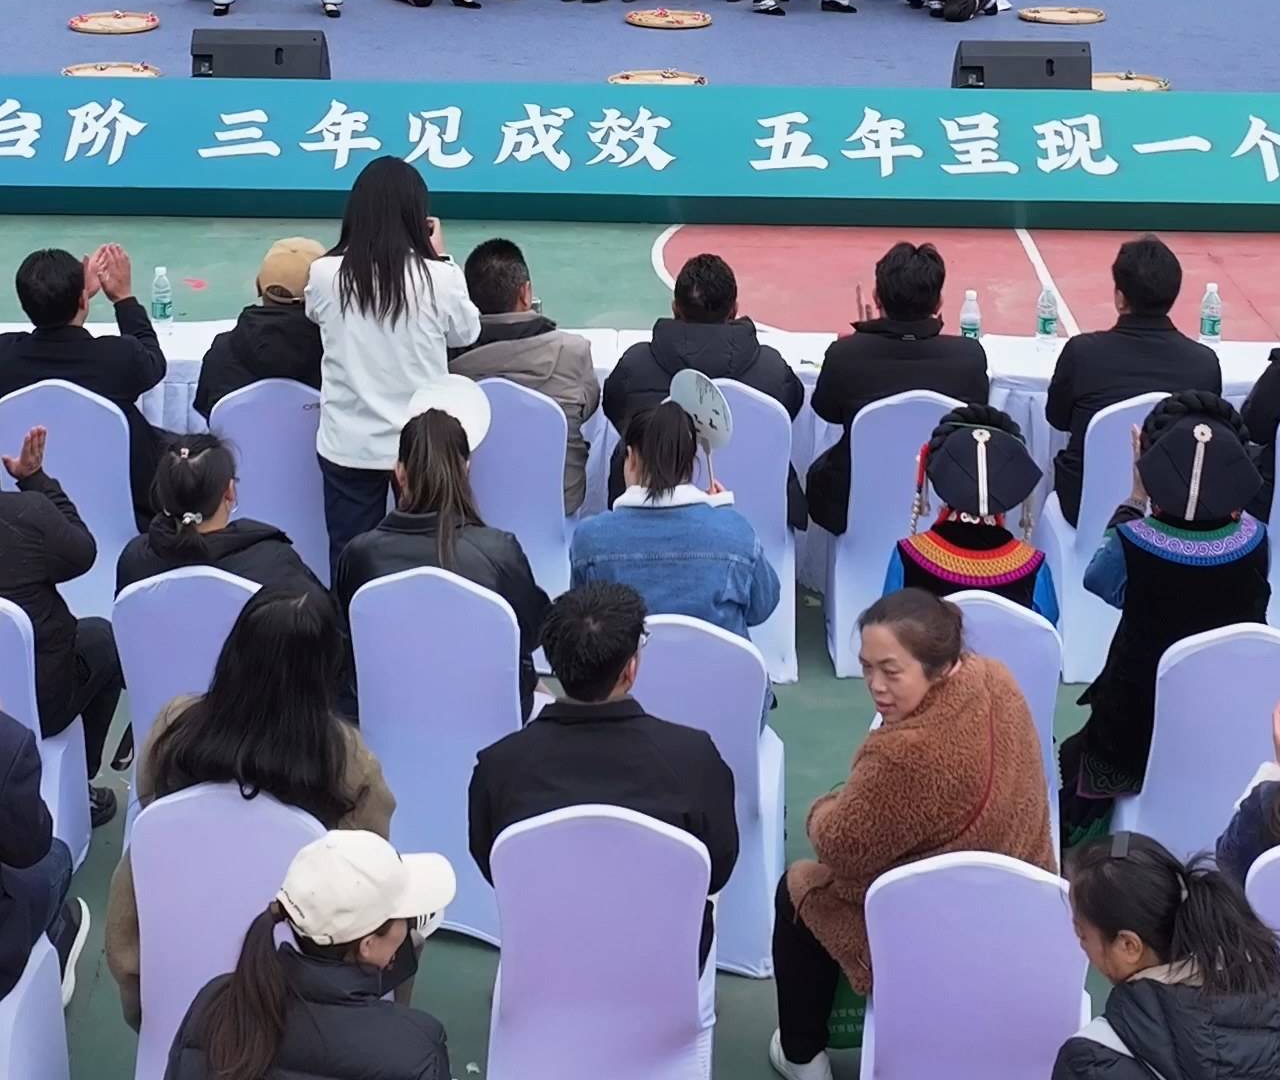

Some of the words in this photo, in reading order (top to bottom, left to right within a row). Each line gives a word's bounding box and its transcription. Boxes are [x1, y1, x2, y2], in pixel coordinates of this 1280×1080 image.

[197, 98, 676, 172] 三年见成效
